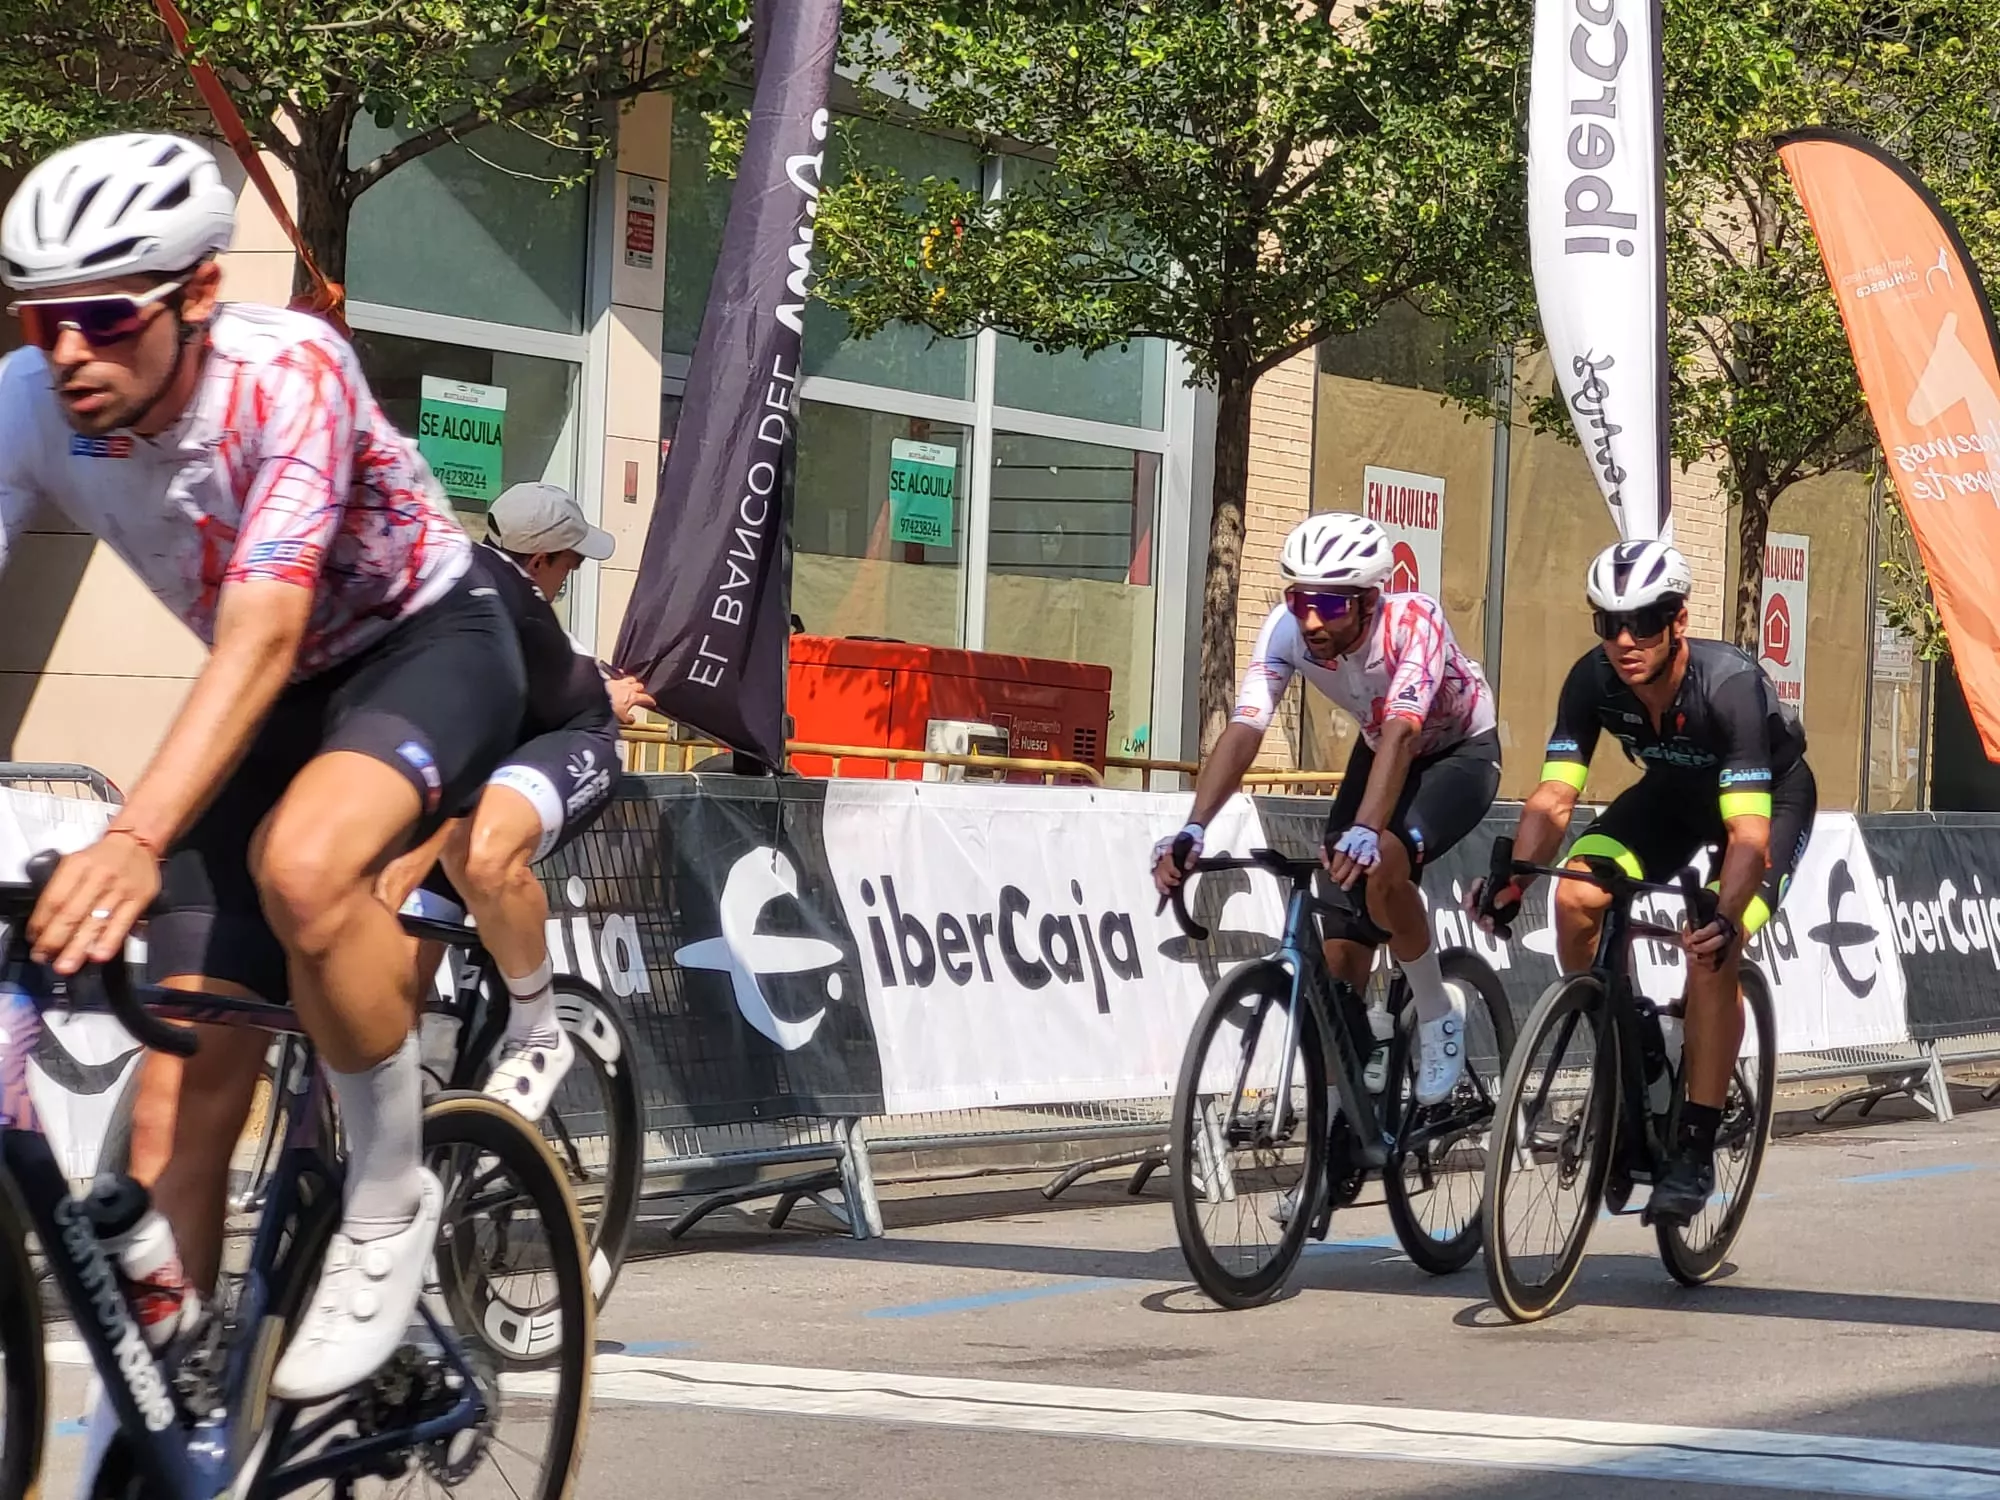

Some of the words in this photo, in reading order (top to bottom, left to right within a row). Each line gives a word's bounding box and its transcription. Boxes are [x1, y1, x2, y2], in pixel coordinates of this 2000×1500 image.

[421, 412, 439, 437] SE
[442, 416, 502, 446] ALQUILA
[890, 470, 906, 492] SE
[907, 473, 953, 498] ALQUILA
[1367, 481, 1383, 522] EN
[1384, 484, 1439, 530] ALQUILER
[1764, 545, 1804, 582] ALQUILER
[1021, 736, 1048, 752] Huesca
[860, 874, 1143, 1014] iberCaja
